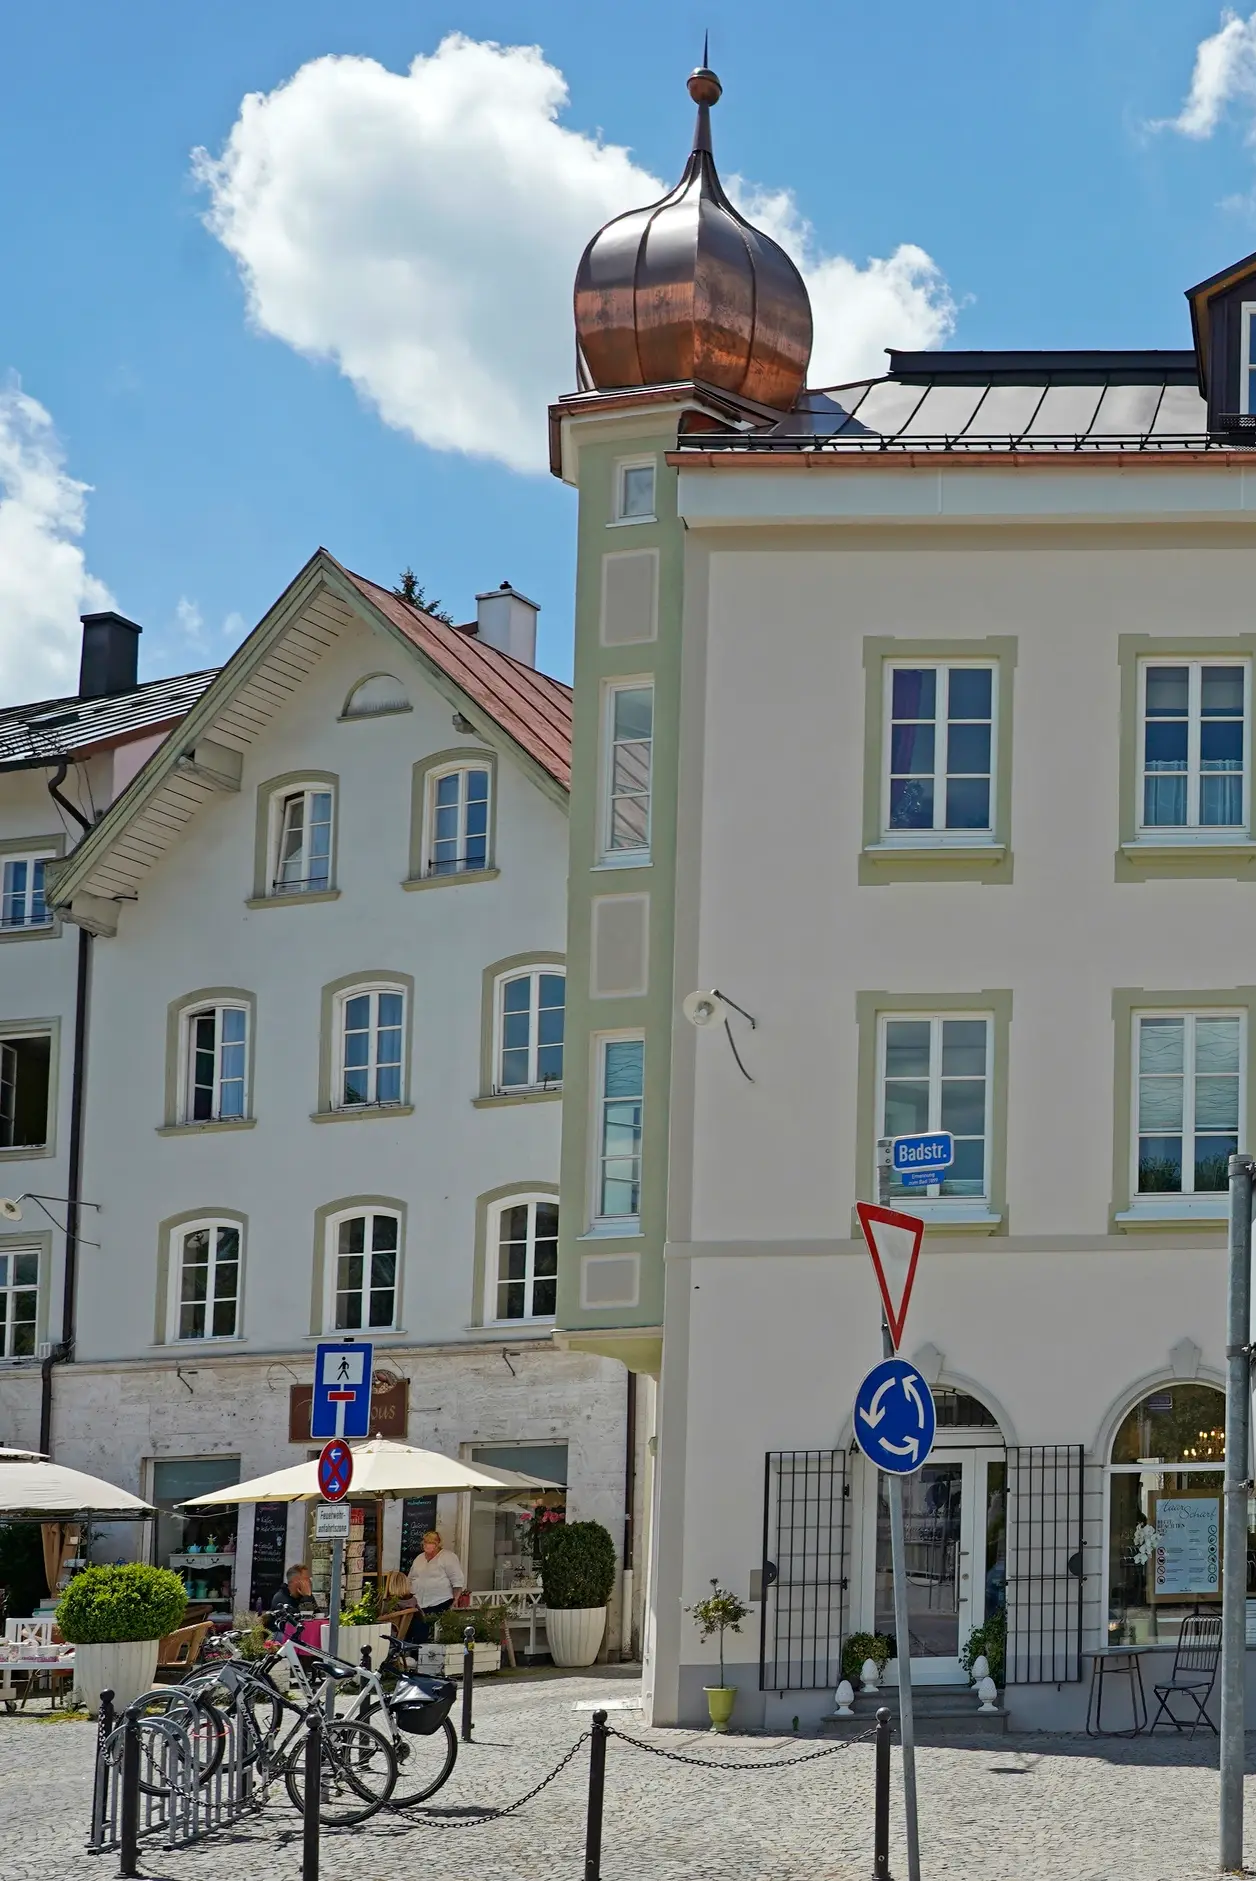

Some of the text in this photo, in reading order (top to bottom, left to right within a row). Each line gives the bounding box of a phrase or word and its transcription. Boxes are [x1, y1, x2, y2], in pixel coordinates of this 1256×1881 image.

[899, 1143, 947, 1162] Badstr.
[320, 1510, 346, 1520] Feuerwehr-
[318, 1524, 347, 1533] anfahrtszone
